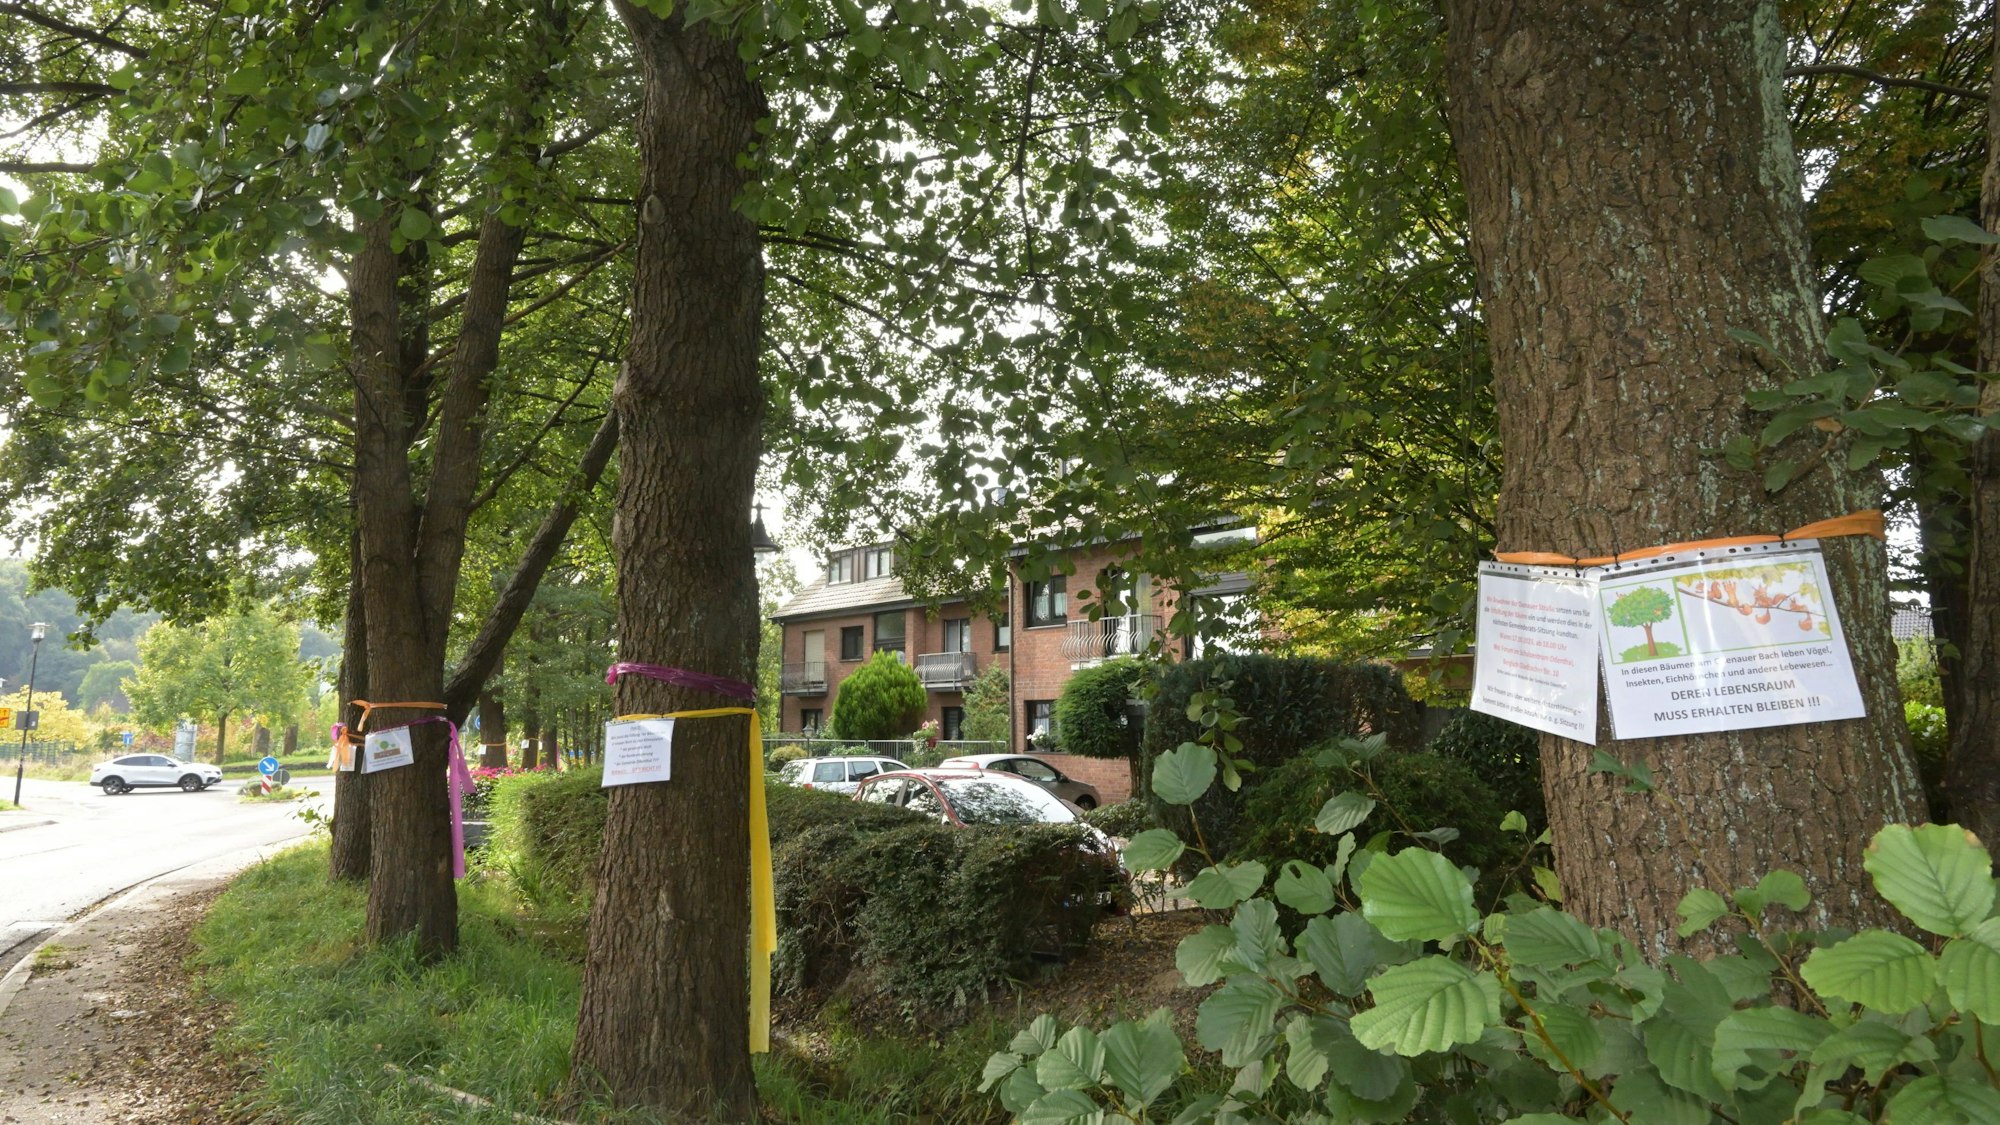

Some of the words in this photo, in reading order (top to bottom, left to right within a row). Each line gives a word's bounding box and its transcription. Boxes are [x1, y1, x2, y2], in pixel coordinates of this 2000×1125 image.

[1631, 665, 1658, 675] diesen
[1660, 662, 1694, 671] Bäumen
[1759, 651, 1779, 660] Bach
[1781, 649, 1804, 658] leben
[1806, 646, 1832, 655] Vögel,
[1626, 677, 1664, 687] Insekten,
[1728, 668, 1745, 677] und
[1748, 665, 1778, 675] andere
[1671, 688, 1711, 701] DEREN
[1714, 680, 1795, 696] LEBENSRAUM
[1654, 710, 1688, 721] MUSS
[1691, 703, 1753, 718] ERHALTEN
[1757, 698, 1804, 712] BLEIBEN
[1807, 696, 1820, 707] !!!
